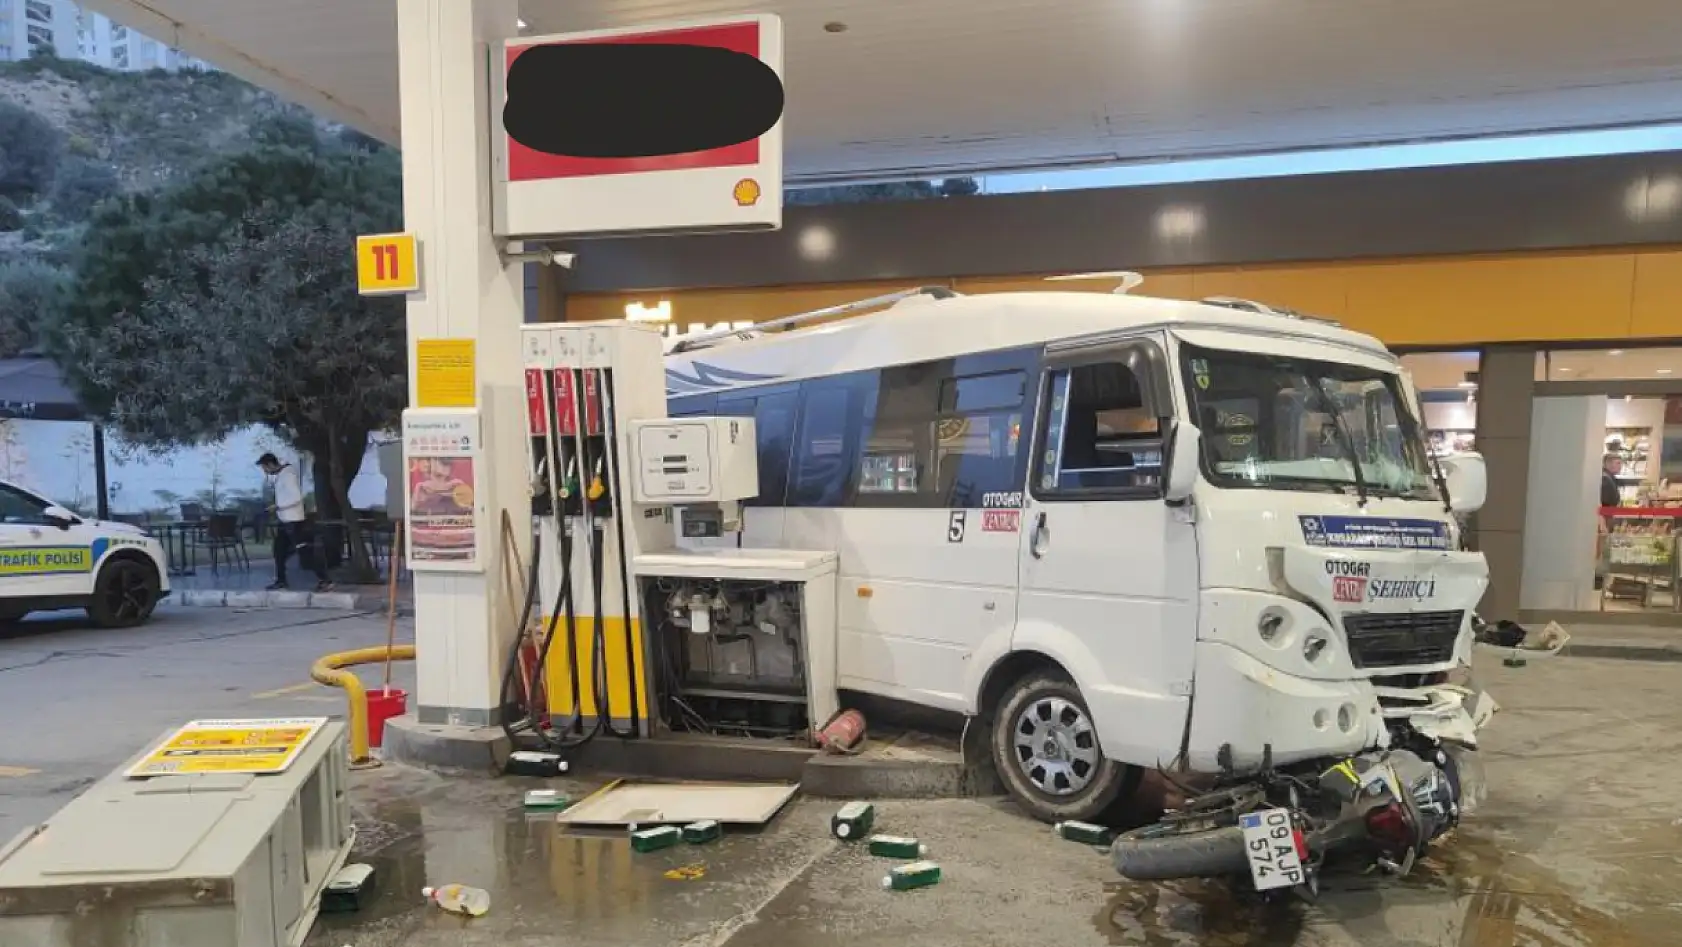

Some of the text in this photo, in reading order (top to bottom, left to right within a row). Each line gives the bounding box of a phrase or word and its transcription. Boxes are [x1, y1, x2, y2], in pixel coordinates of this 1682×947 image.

[372, 244, 399, 280] 11
[949, 510, 965, 542] 5
[44, 550, 83, 566] POLİSİ
[1325, 559, 1371, 577] OTOGAR
[1249, 838, 1276, 876] 574
[1267, 813, 1299, 882] 09 AJP
